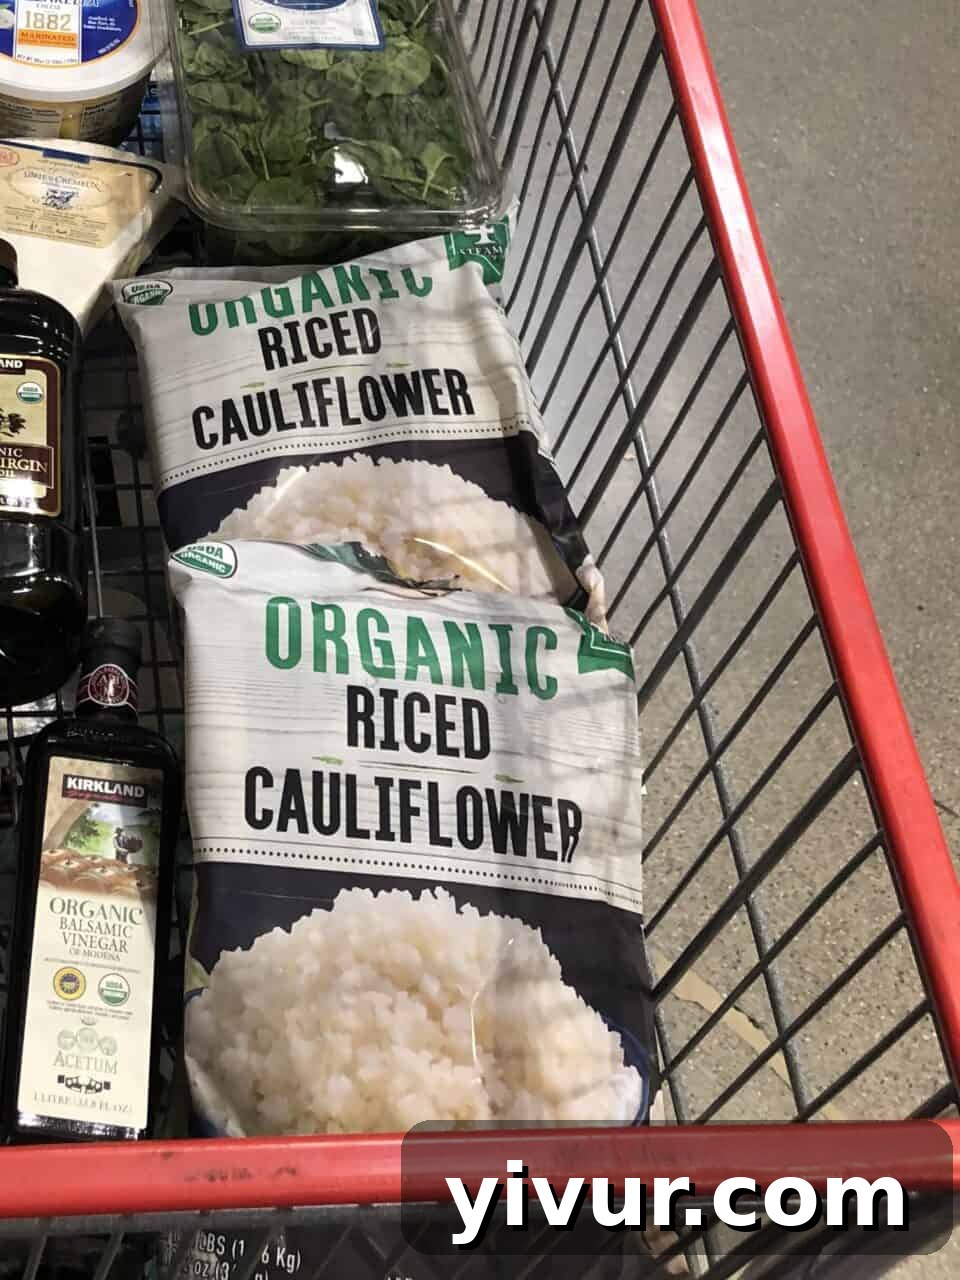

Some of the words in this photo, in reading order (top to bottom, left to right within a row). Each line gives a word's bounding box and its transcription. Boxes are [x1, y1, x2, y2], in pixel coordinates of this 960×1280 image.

[25, 11, 71, 31] 1882
[258, 308, 381, 370] RICED
[192, 368, 474, 450] CAULIFLOWER
[265, 596, 558, 700] ORGANIC
[346, 685, 491, 760] RICED
[67, 775, 145, 798] KIRKLAND
[244, 765, 583, 864] CAULIFLOWER
[49, 897, 143, 925] ORGANIC
[59, 917, 132, 939] BALSAMIC
[61, 932, 128, 954] VINEGAR
[53, 1051, 119, 1075] ACETUM
[275, 1243, 302, 1273] Kg)
